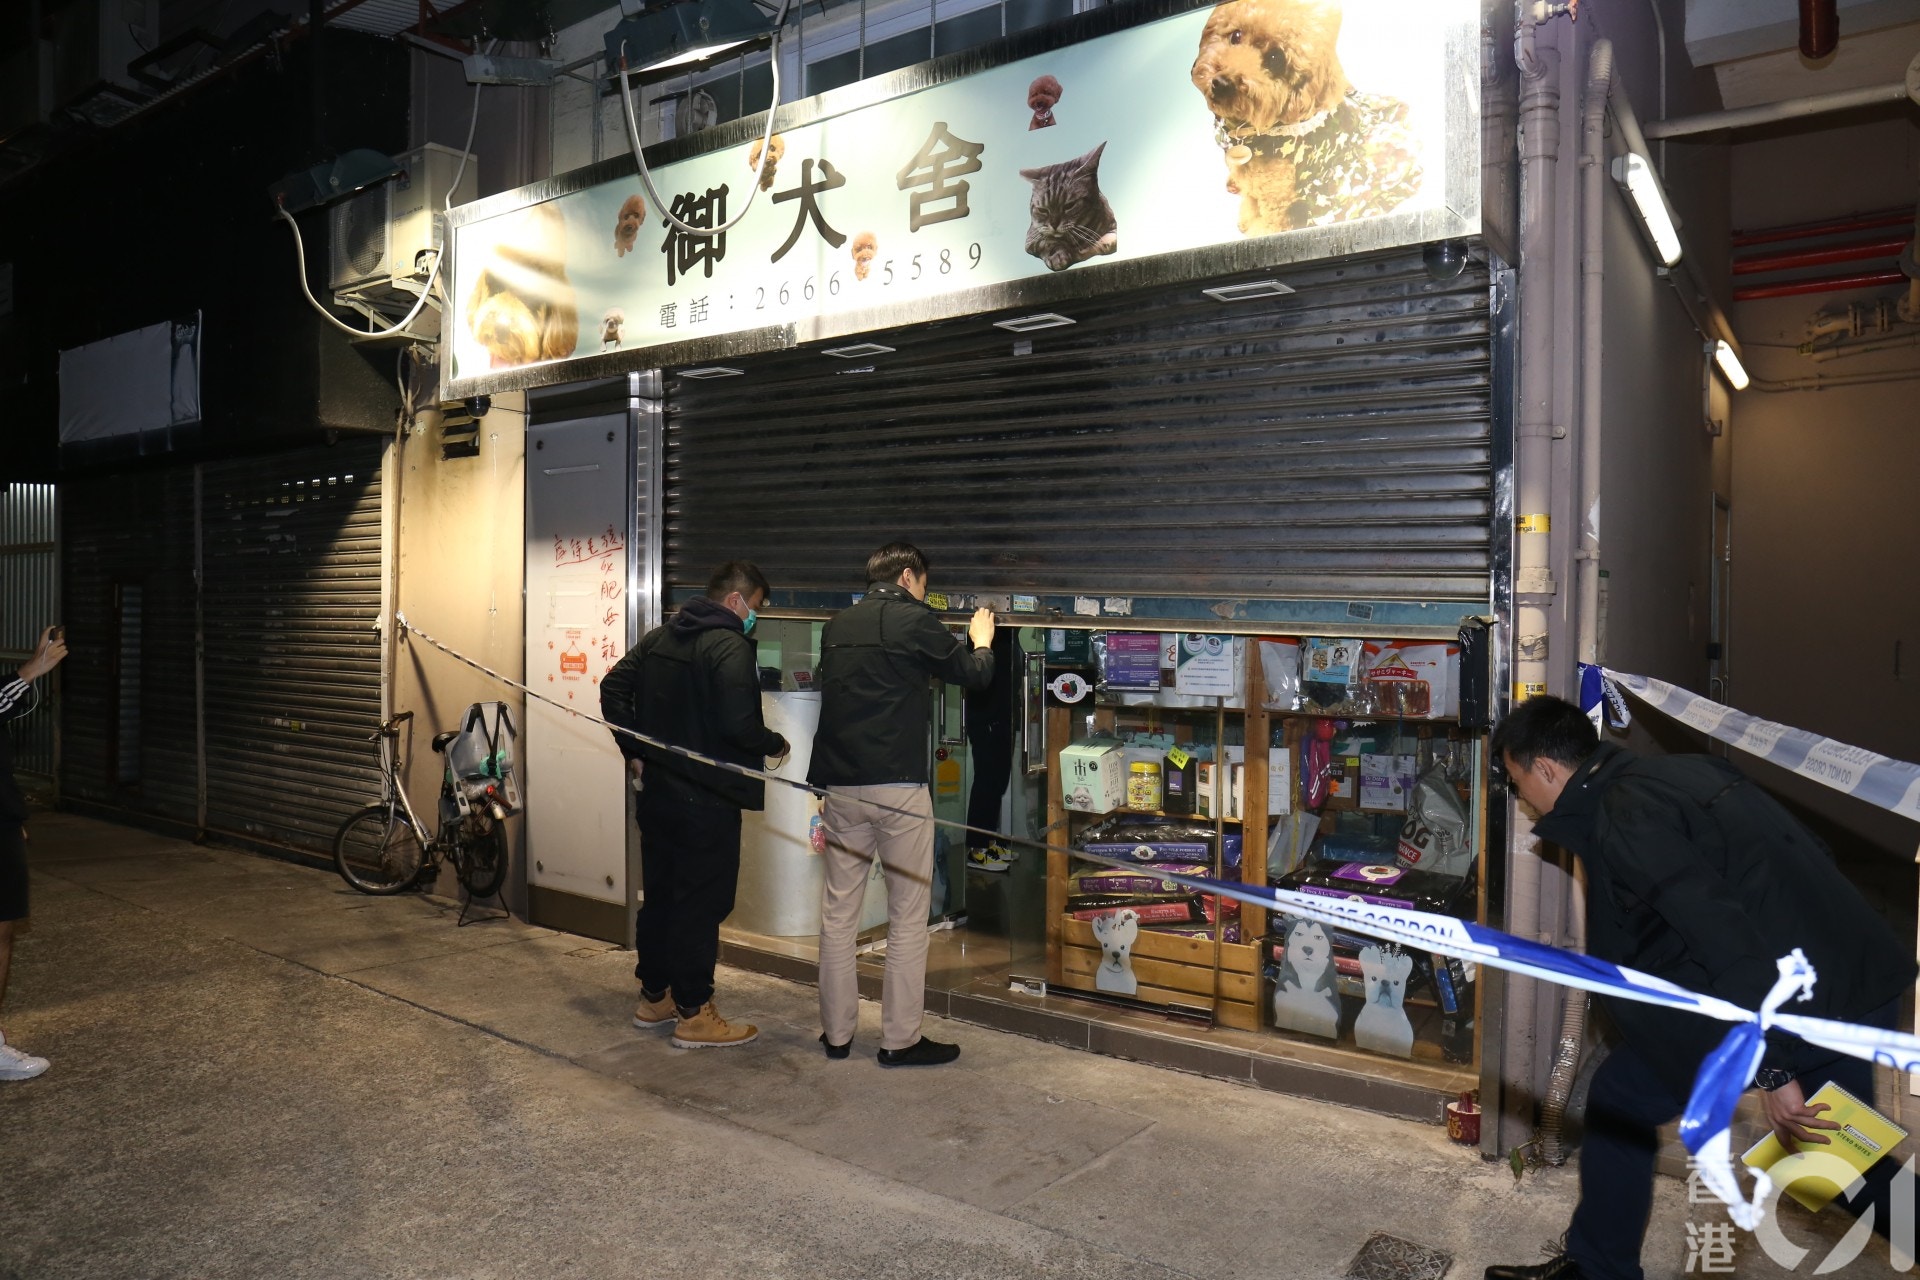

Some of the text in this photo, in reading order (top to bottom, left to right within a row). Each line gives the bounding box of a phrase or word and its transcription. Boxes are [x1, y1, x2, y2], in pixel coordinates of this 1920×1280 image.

[661, 120, 985, 287] 御犬舍
[755, 270, 842, 311] 2666
[882, 241, 983, 287] 5589
